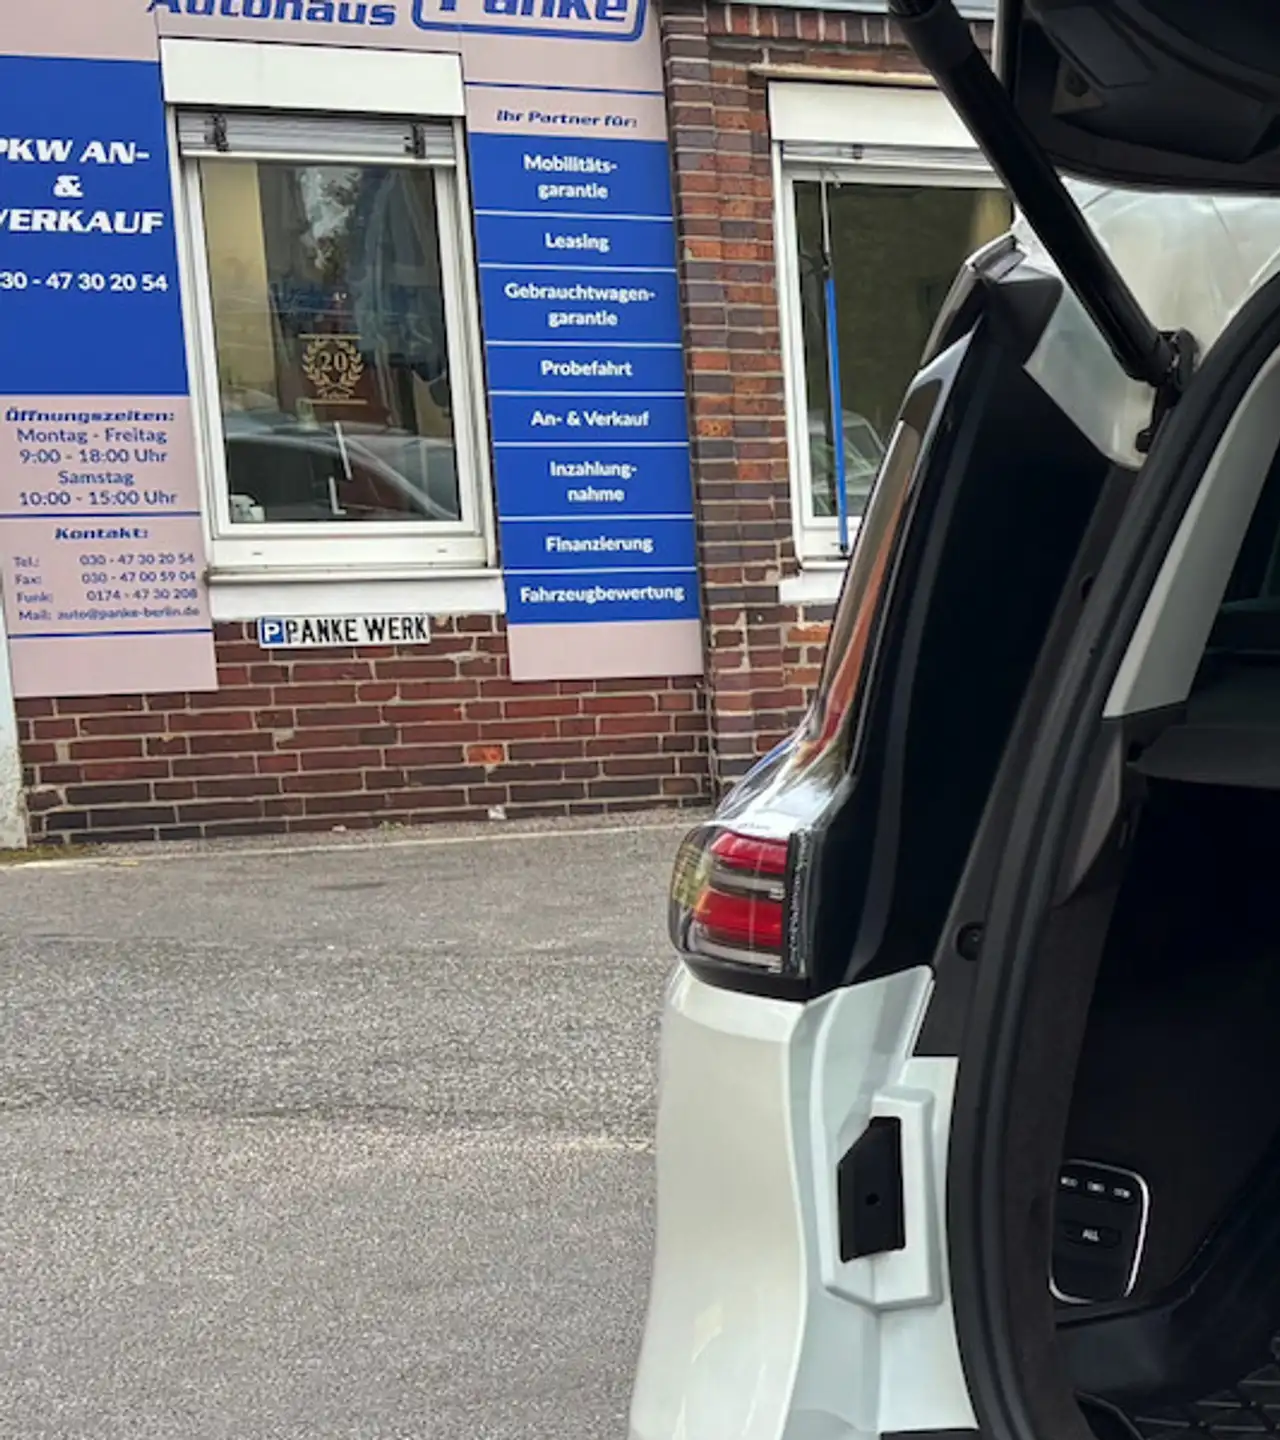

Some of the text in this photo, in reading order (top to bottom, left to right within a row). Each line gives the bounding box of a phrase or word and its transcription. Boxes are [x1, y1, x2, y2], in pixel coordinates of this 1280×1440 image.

[497, 109, 638, 128] Ihr Partner für:
[80, 140, 149, 165] AN-
[523, 154, 617, 174] Mobilitäts-
[53, 174, 83, 198] &
[538, 183, 608, 200] garantie
[544, 232, 610, 253] Leasing
[46, 272, 73, 290] 47
[78, 273, 104, 291] 30
[110, 274, 136, 292] 20
[142, 274, 169, 292] 54
[504, 281, 655, 304] Gebrauchtwagen-
[548, 310, 618, 328] garantie
[319, 350, 348, 372] 20
[540, 359, 633, 377] Probefahrt
[5, 406, 175, 424] Öffnungszeiten:
[531, 411, 650, 427] An- & Verkauf
[16, 427, 88, 444] Montag
[104, 427, 167, 444] Freitag
[19, 448, 61, 464] 9:00
[79, 448, 129, 463] 18:00
[134, 448, 168, 463] Uhr
[57, 470, 135, 486] Samstag
[550, 460, 637, 480] Inzahlung-
[19, 491, 71, 506] 10:00
[88, 490, 140, 506] 15:00
[143, 490, 177, 505] Uhr
[567, 485, 625, 502] nahme
[54, 526, 149, 540] Kontakt:
[545, 535, 654, 554] Finanzierung
[79, 554, 106, 566] 030
[117, 553, 134, 565] 47
[138, 553, 155, 564] 30
[158, 553, 175, 564] 20
[178, 552, 195, 564] 54
[15, 573, 42, 585] Fax:
[119, 572, 135, 583] 47
[139, 571, 157, 583] 00
[133, 589, 149, 600] 47
[520, 585, 685, 604] Fahrzeugbewertung
[18, 609, 52, 621] Mail:
[264, 616, 428, 644] P PANKE WERK
